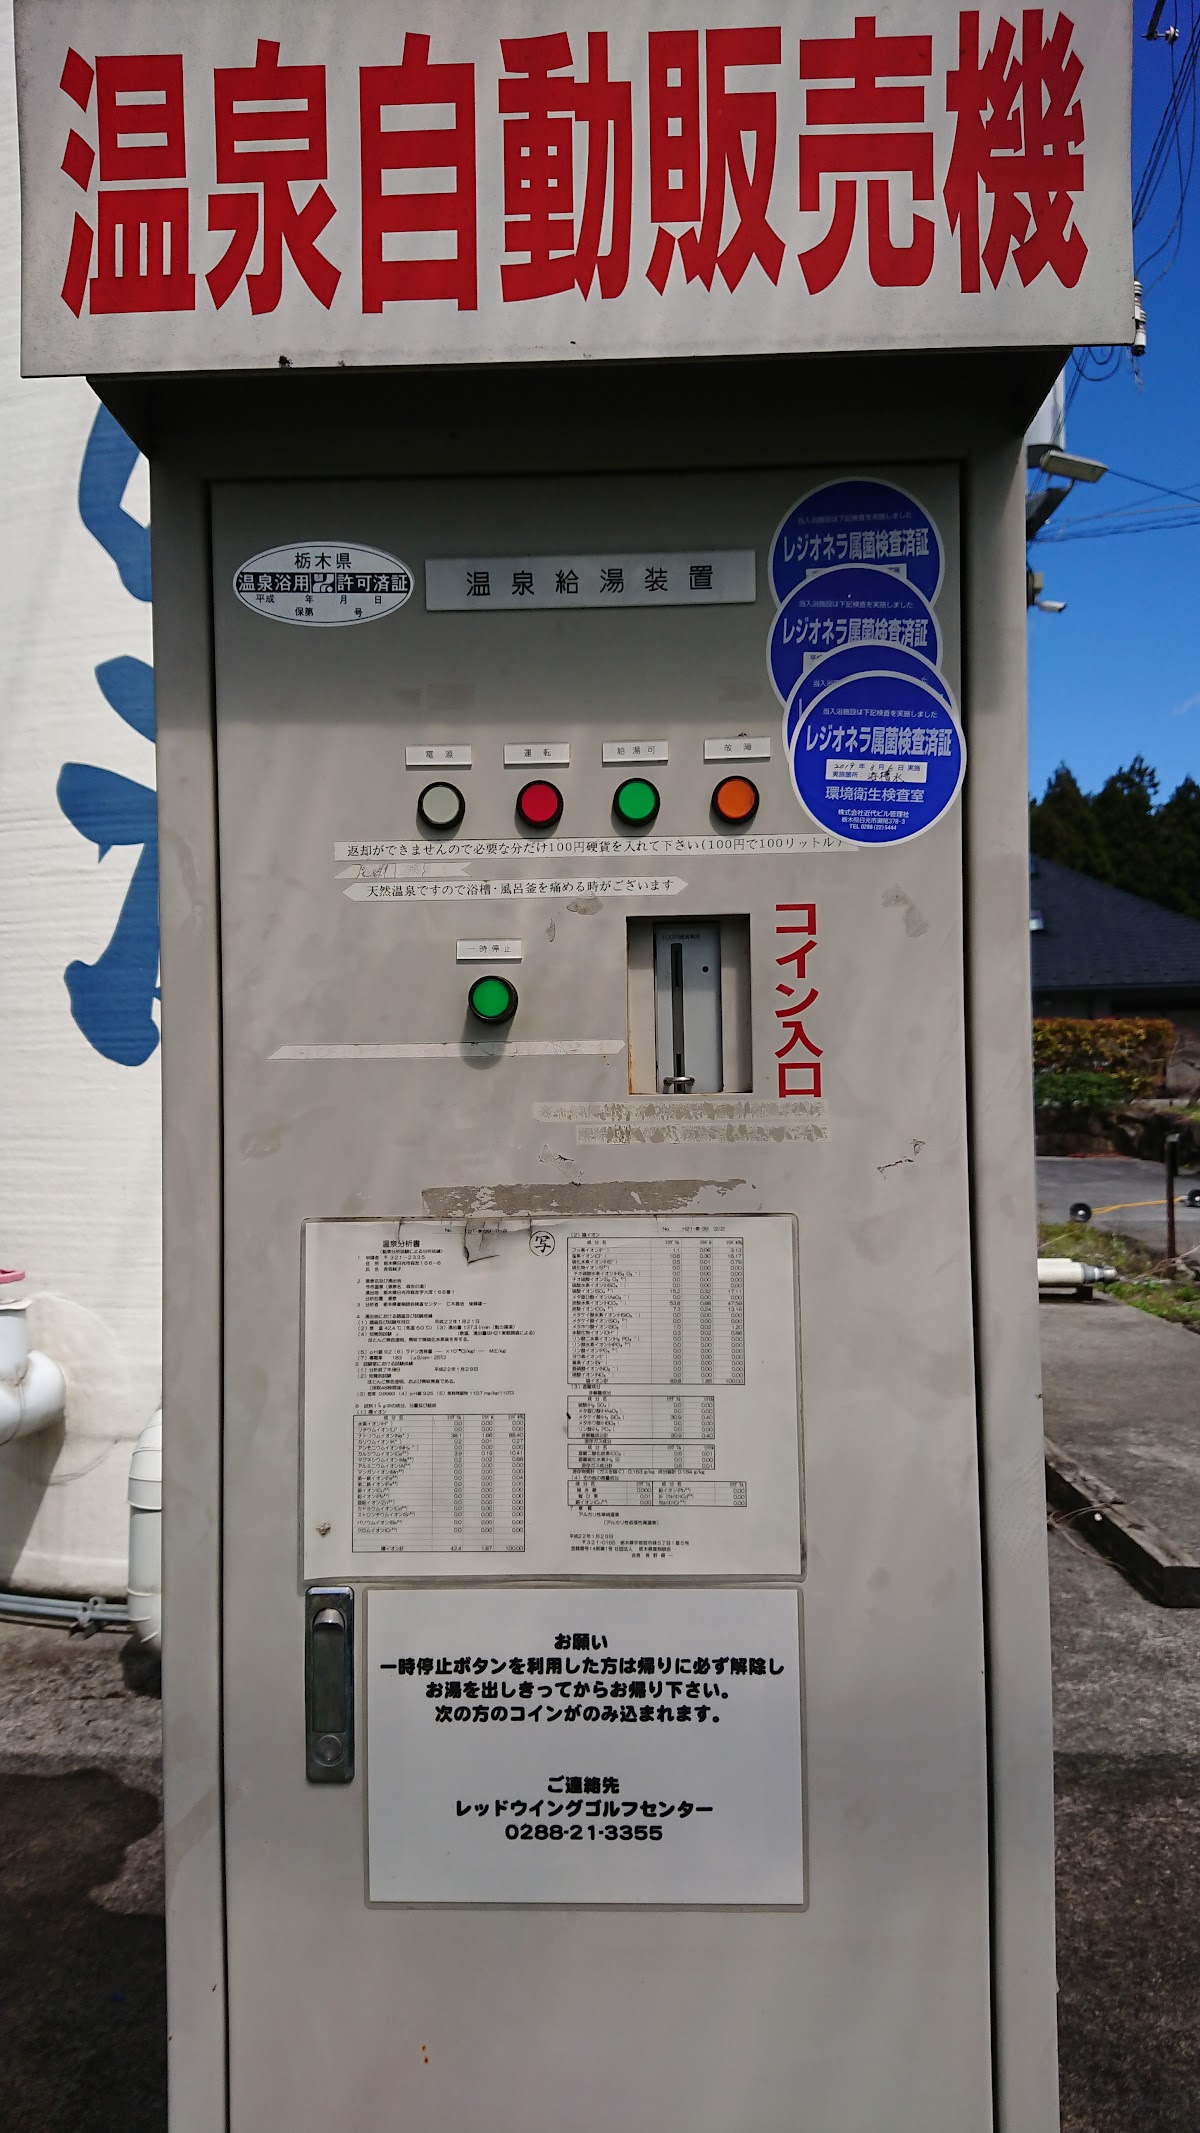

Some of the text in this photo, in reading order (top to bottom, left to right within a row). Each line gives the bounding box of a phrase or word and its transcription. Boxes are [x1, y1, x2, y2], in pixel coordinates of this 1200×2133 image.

[60, 8, 1088, 319] 温泉自動販売機
[783, 528, 929, 563] レジオネラ属菌検査済証
[294, 552, 352, 570] 栃木県
[238, 574, 408, 592] 温泉浴用 許可済証
[466, 565, 713, 597] 温泉給湯装置
[783, 617, 928, 647] レジオネラ属菌検査済証
[806, 724, 952, 757] レジオネラ属菌検査済証
[825, 786, 924, 802] 環境衛生検査室
[367, 879, 673, 898] 天然温泉ですので浴槽・風呂釜を痛める時がございます
[774, 903, 823, 1098] コイン入口
[554, 1633, 608, 1651] お願い
[380, 1657, 784, 1675] 一時停止ボタンを利用した方は帰りに必ず解除し
[426, 1681, 729, 1700] お湯を出しきってからお帰り下さい。
[435, 1705, 721, 1723] 次の方のコインがのみ込まれます。
[547, 1776, 620, 1794] ご連絡先
[455, 1800, 713, 1818] レッドウイングゴルフセンター
[505, 1824, 663, 1841] 0288-21-3355
